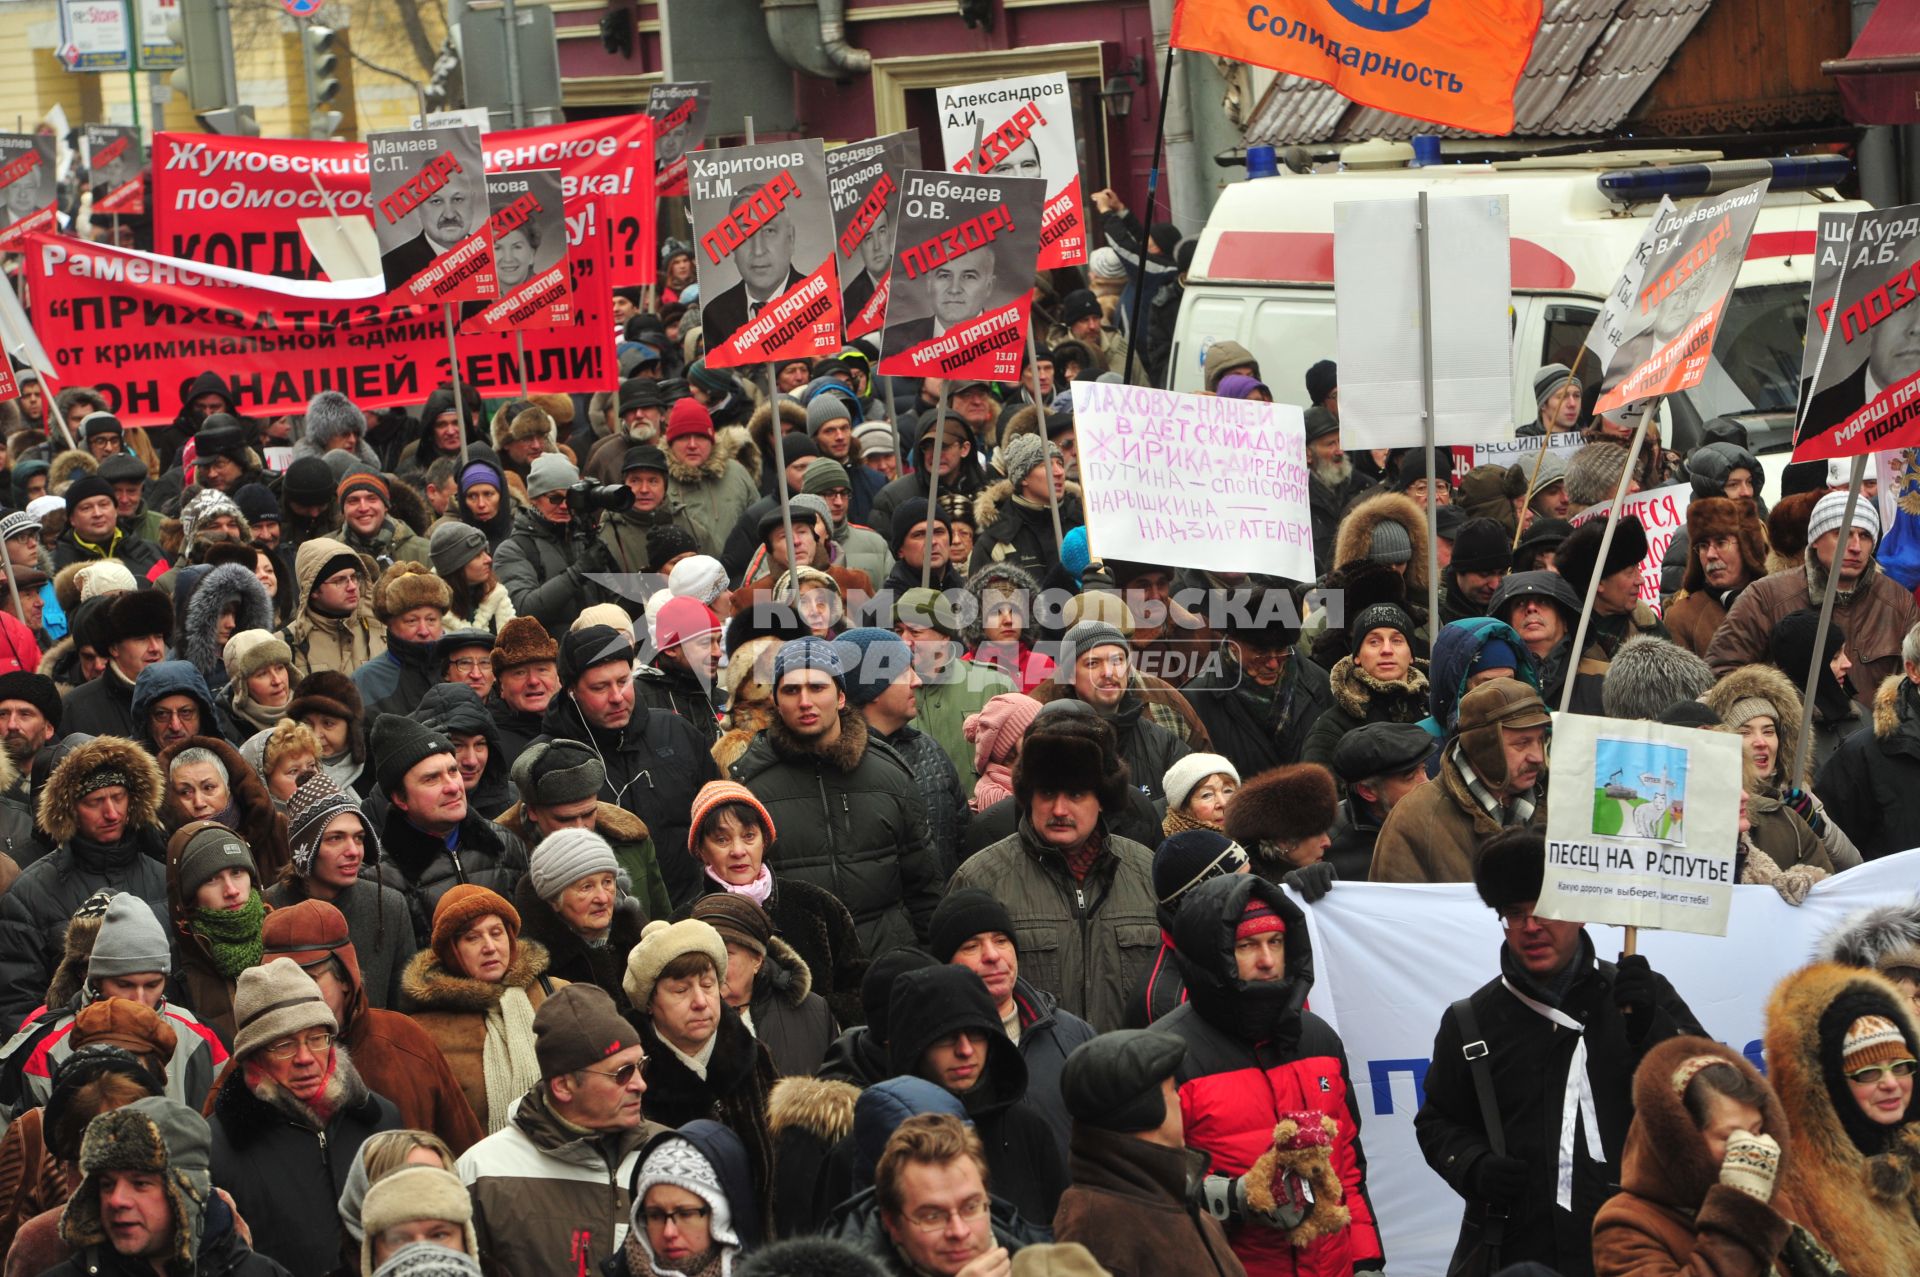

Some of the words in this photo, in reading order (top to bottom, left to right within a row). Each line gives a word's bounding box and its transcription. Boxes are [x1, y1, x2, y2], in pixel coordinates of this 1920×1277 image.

[1247, 4, 1464, 95] Солидарность
[945, 83, 1065, 111] Александров
[165, 142, 370, 176] Жуковский
[372, 138, 438, 155] Мамаев
[826, 144, 885, 165] Федяев
[373, 156, 408, 172] С.П.
[693, 152, 804, 179] Харитонов
[379, 151, 463, 225] ПОЗОР!
[561, 167, 634, 197] вка!
[696, 179, 738, 200] Н.М.
[830, 162, 884, 197] Дроздов
[907, 178, 1001, 202] Лебедев
[832, 188, 862, 212] И.Ю.
[906, 200, 950, 220] О.В.
[1663, 188, 1759, 234] Поневежский
[700, 169, 802, 265] ПОЗОР!
[839, 172, 897, 259] ПОЗОР!
[900, 203, 1016, 280] ПОЗОР!
[1060, 237, 1081, 248] 13.01
[1656, 234, 1683, 255] В.А.
[1858, 218, 1920, 246] Курд
[409, 265, 445, 296] МАРШ
[443, 235, 488, 273] ПРОТИВ
[1640, 213, 1732, 317] ПОЗОР!
[1852, 242, 1900, 269] А.Б.
[433, 252, 490, 298] ПОДЛЕЦОВ
[475, 274, 493, 283] 13.01
[476, 285, 494, 294] 2013
[484, 295, 520, 325] МАРШ
[518, 268, 564, 306] ПРОТИВ
[508, 284, 567, 326] ПОДЛЕЦОВ
[550, 304, 569, 312] 13.01
[862, 289, 887, 324] МАРШ
[551, 313, 570, 322] 2013
[733, 314, 776, 354] МАРШ
[773, 275, 828, 323] ПРОТИВ
[761, 295, 833, 355] ПОДЛЕЦОВ
[812, 323, 835, 334] 13.01
[56, 347, 84, 366] от
[95, 324, 336, 368] криминальной
[814, 336, 835, 347] 2013
[912, 337, 960, 366] МАРШ
[960, 307, 1021, 345] ПРОТИВ
[941, 326, 1021, 374] ПОДЛЕЦОВ
[995, 351, 1017, 361] 13.01
[1622, 356, 1661, 396] МАРШ
[1665, 311, 1713, 362] ПРОТИВ
[1685, 356, 1705, 368] 13.01
[229, 354, 419, 406] НАШЕЙ
[435, 346, 603, 388] ЗЕМЛИ!
[994, 364, 1015, 374] 2013
[1115, 415, 1132, 435] В
[1140, 416, 1251, 449] ДЕТСКИЙ
[1834, 399, 1889, 446] МАРШ
[1089, 462, 1185, 490] ПУТИНА
[1088, 489, 1218, 517] НАРЫШКИНА
[1138, 515, 1312, 553] НАДЗИРАТЕЛЕМ
[1550, 842, 1600, 873] ПЕСЕЦ
[1606, 847, 1635, 870] НА
[1558, 881, 1579, 893] Какую
[1580, 884, 1602, 895] дорогу
[1617, 887, 1659, 900] выберет,
[1680, 895, 1688, 903] от
[1690, 895, 1710, 906] тебя!
